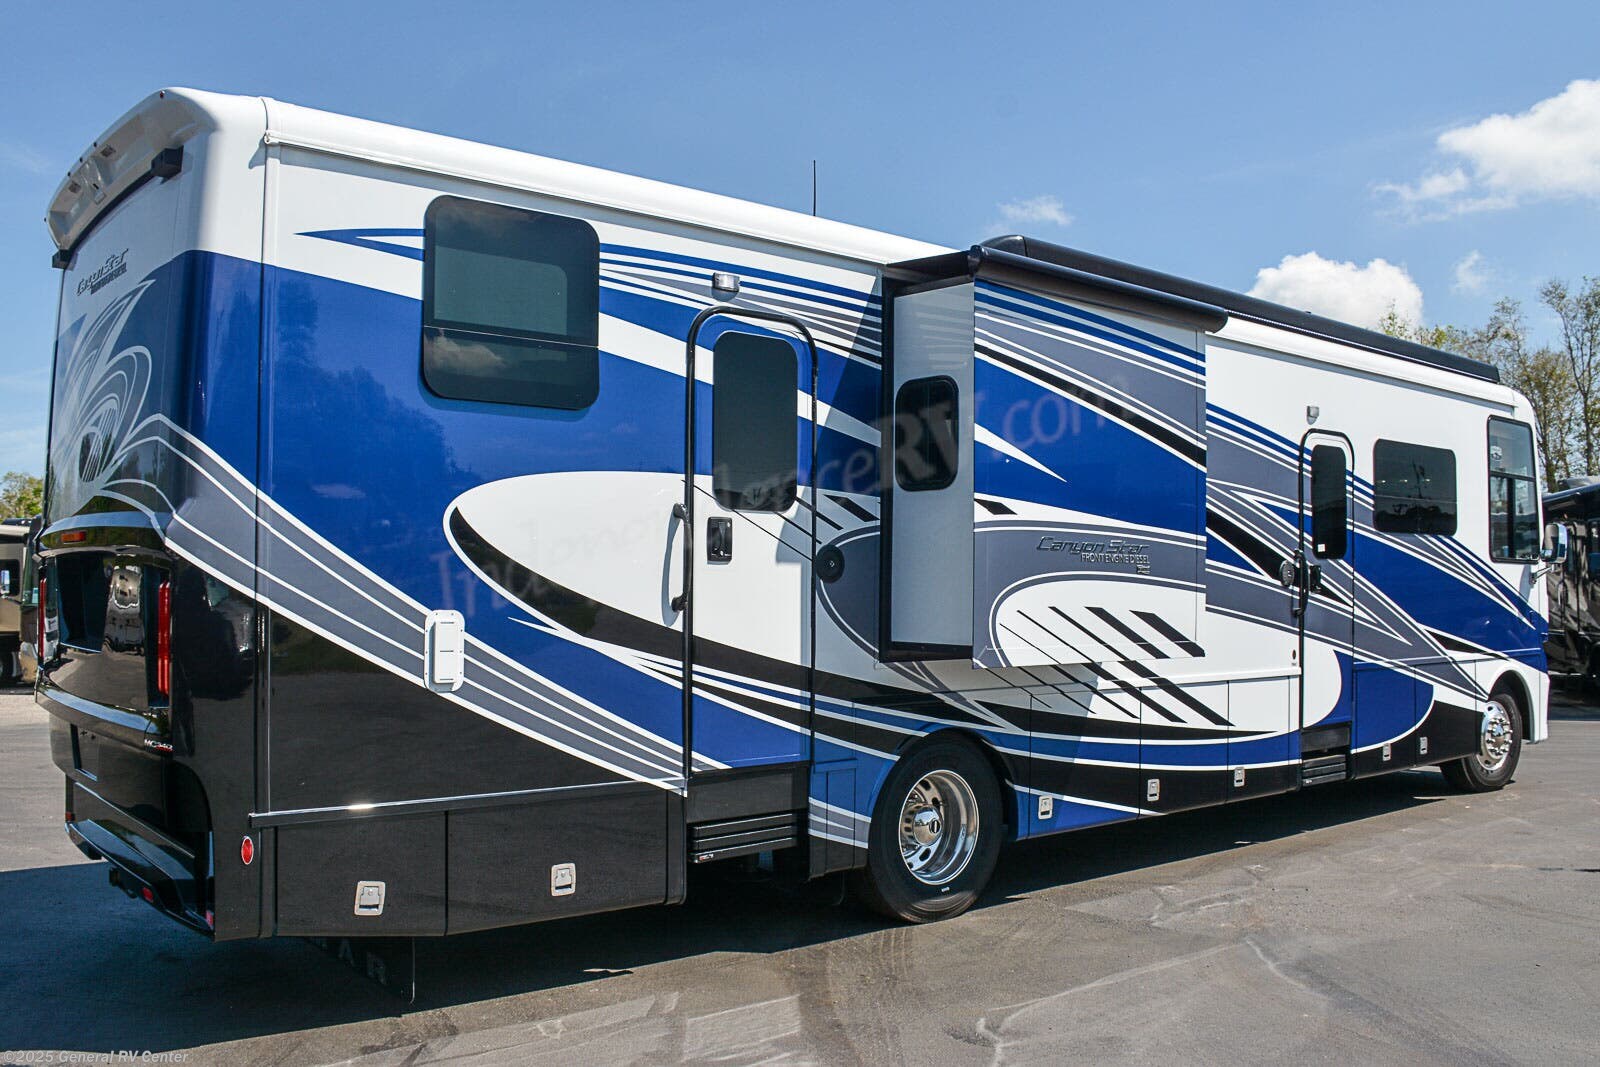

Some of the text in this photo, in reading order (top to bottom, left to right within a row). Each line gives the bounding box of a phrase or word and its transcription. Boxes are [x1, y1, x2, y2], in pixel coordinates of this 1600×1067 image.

[1036, 536, 1150, 554] Canyon Star
[1081, 552, 1151, 564] FRONT ENGINE DIESEL
